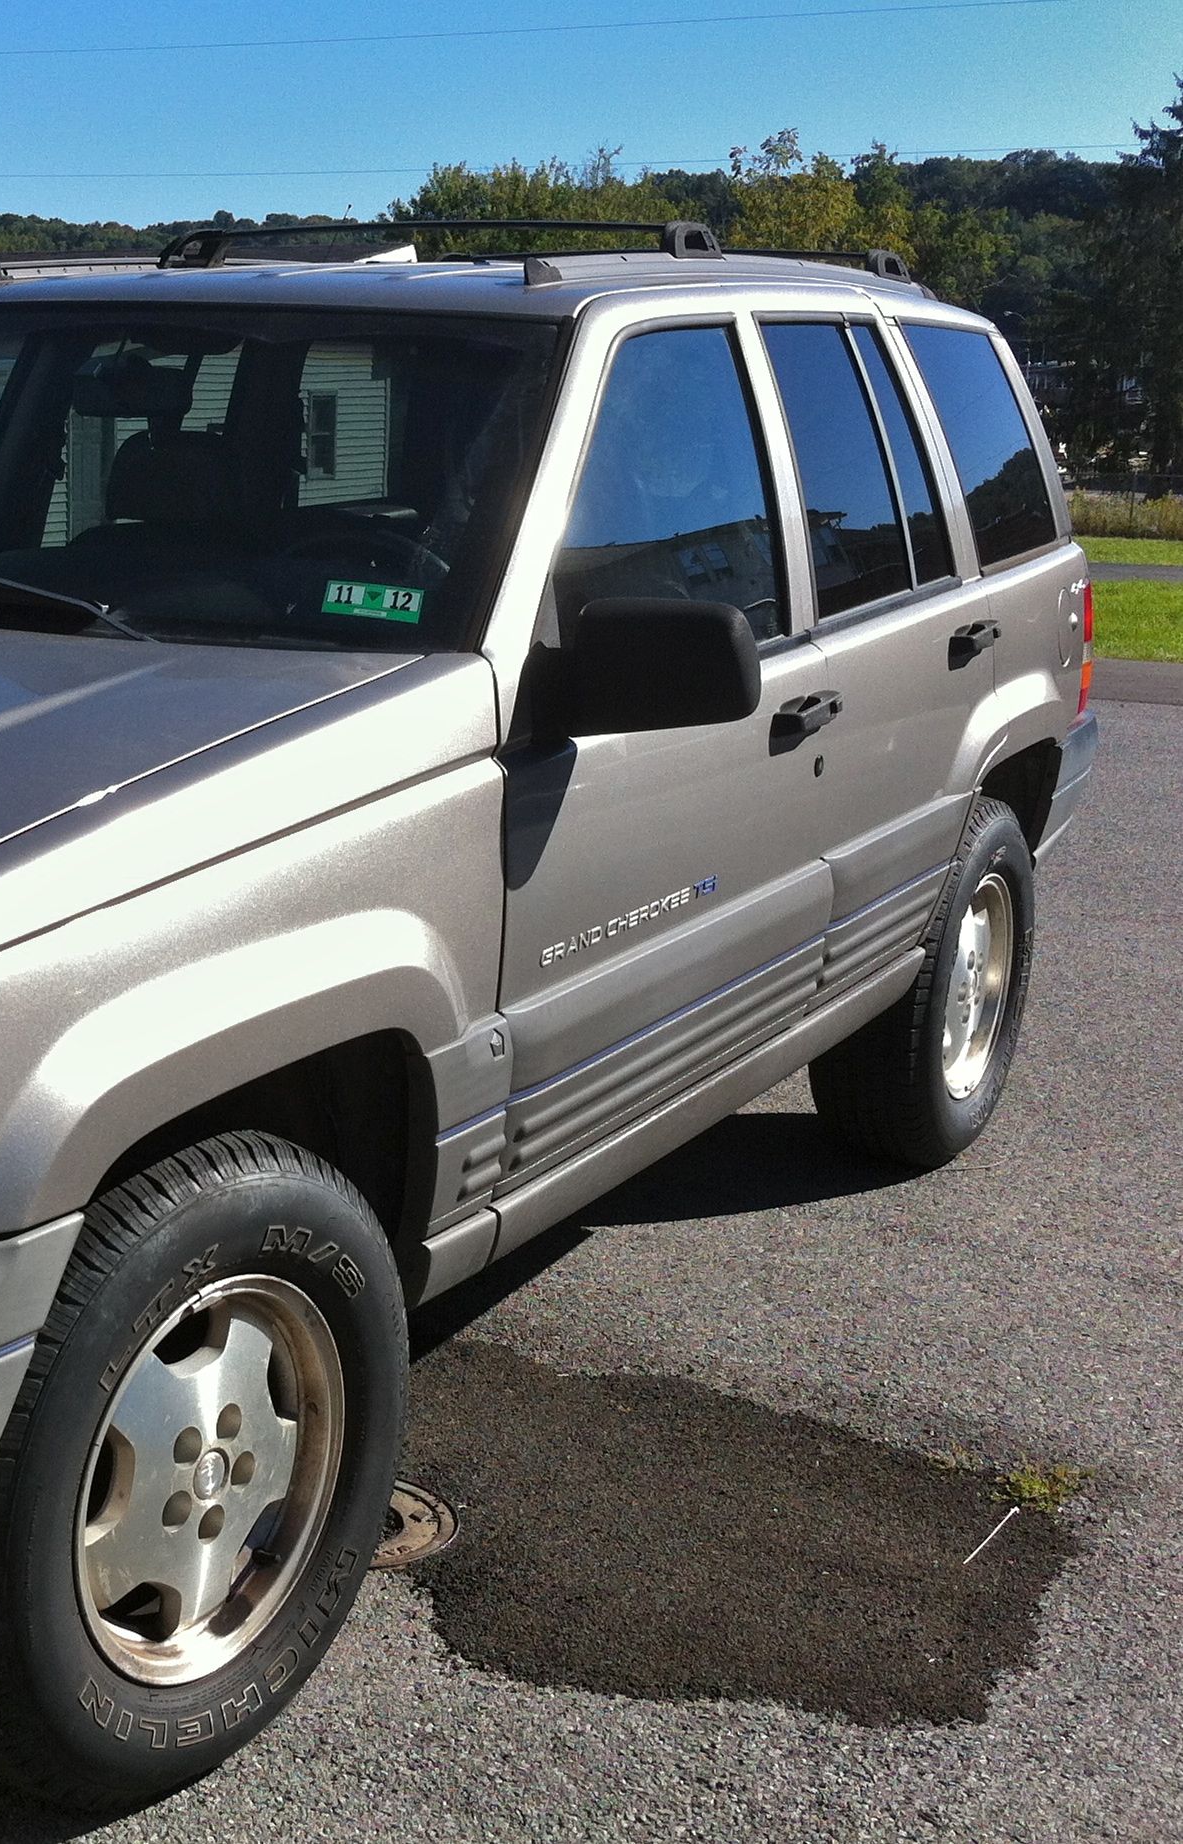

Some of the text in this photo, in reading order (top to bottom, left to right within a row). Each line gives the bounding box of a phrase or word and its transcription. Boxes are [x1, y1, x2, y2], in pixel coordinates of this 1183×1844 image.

[334, 585, 413, 611] 11 12
[540, 925, 603, 968] GRAND
[605, 886, 691, 938] CHEROKEE
[98, 1225, 366, 1392] LTX M/S
[78, 1545, 359, 1750] MICHELIN
